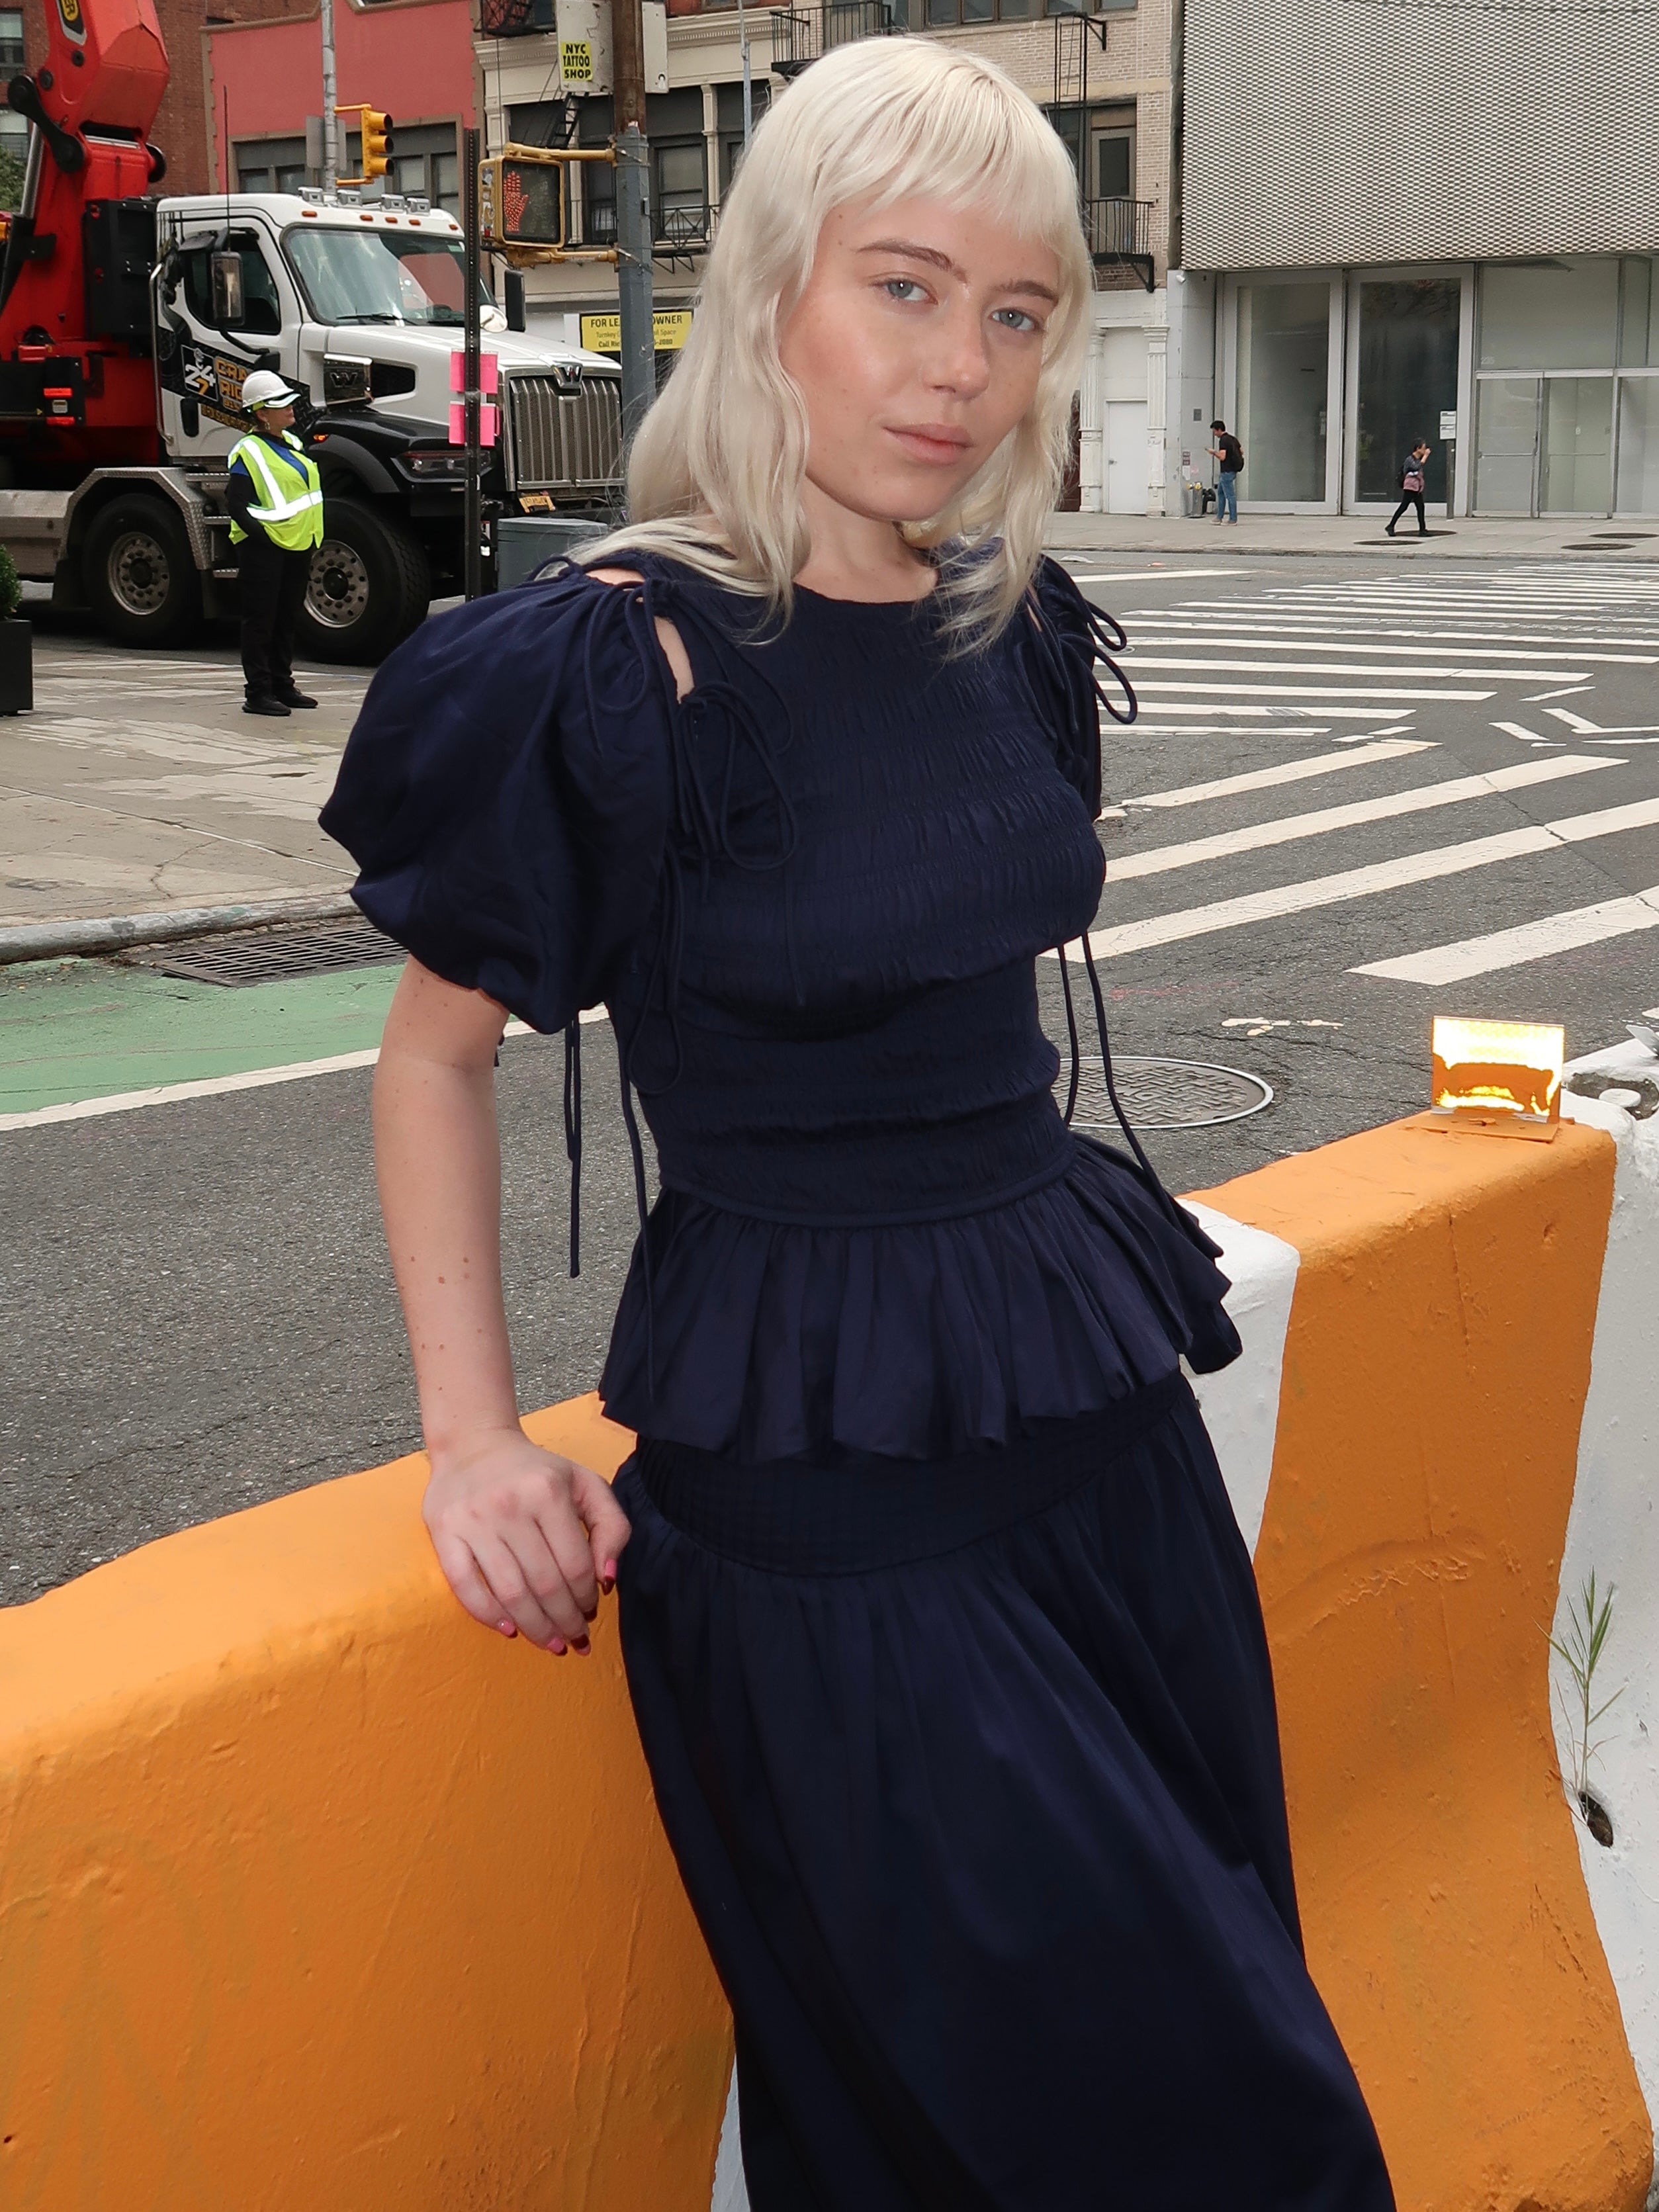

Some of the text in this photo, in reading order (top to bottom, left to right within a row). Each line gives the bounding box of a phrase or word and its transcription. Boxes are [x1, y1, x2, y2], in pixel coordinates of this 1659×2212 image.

[566, 44, 586, 54] NYC
[563, 55, 590, 67] TATTOO
[564, 69, 591, 79] SHOP
[590, 318, 607, 328] FOR
[609, 318, 620, 327] LE
[216, 359, 249, 382] CRA
[220, 379, 243, 402] RIG
